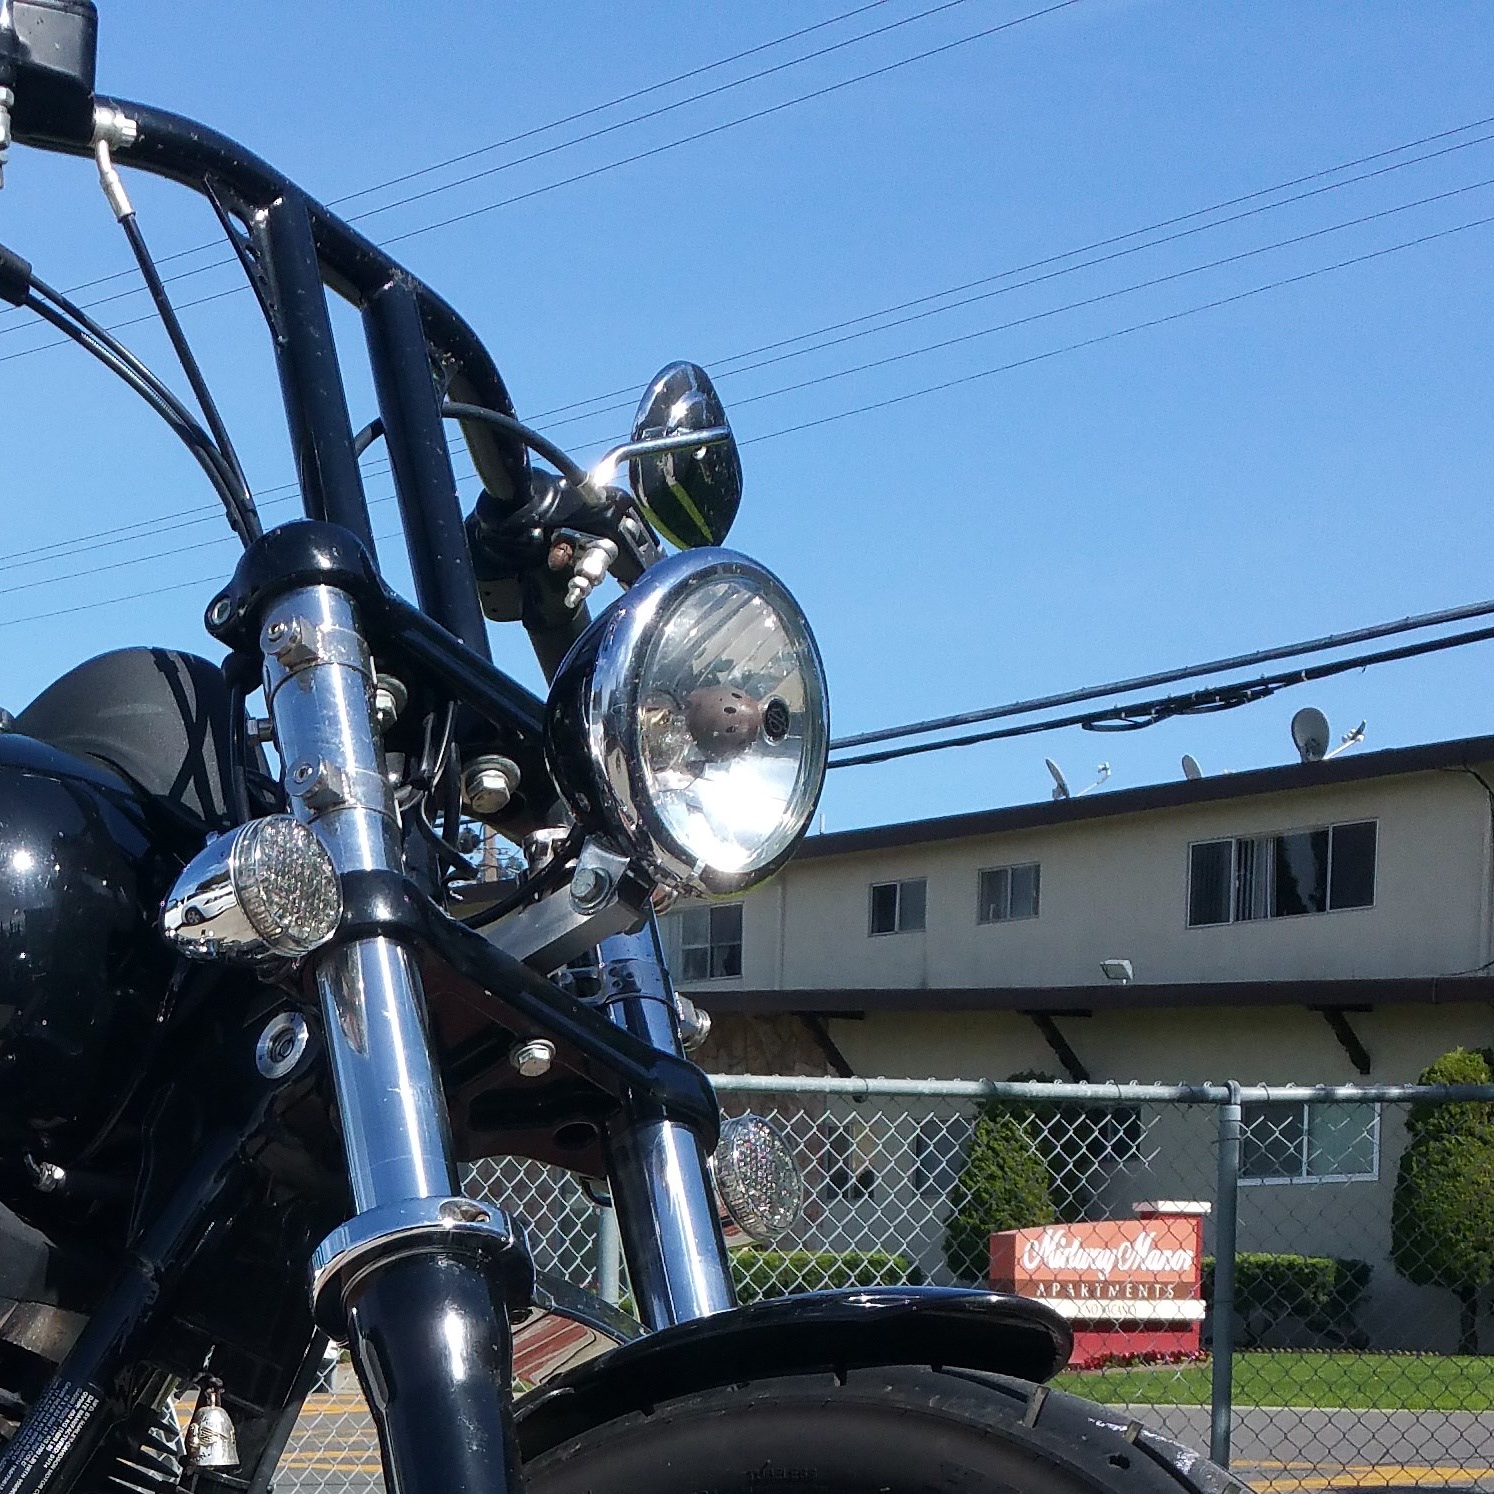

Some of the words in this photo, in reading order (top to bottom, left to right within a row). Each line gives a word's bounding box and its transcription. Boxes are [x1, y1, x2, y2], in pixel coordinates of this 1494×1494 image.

[1022, 1229, 1117, 1281] Midway
[1117, 1231, 1196, 1271] Manor
[1036, 1282, 1176, 1299] APARTMENTS
[80, 1394, 94, 1410] DATE
[50, 1419, 85, 1470] HARLEY-DAVIDSON
[36, 1468, 53, 1489] MOTOR
